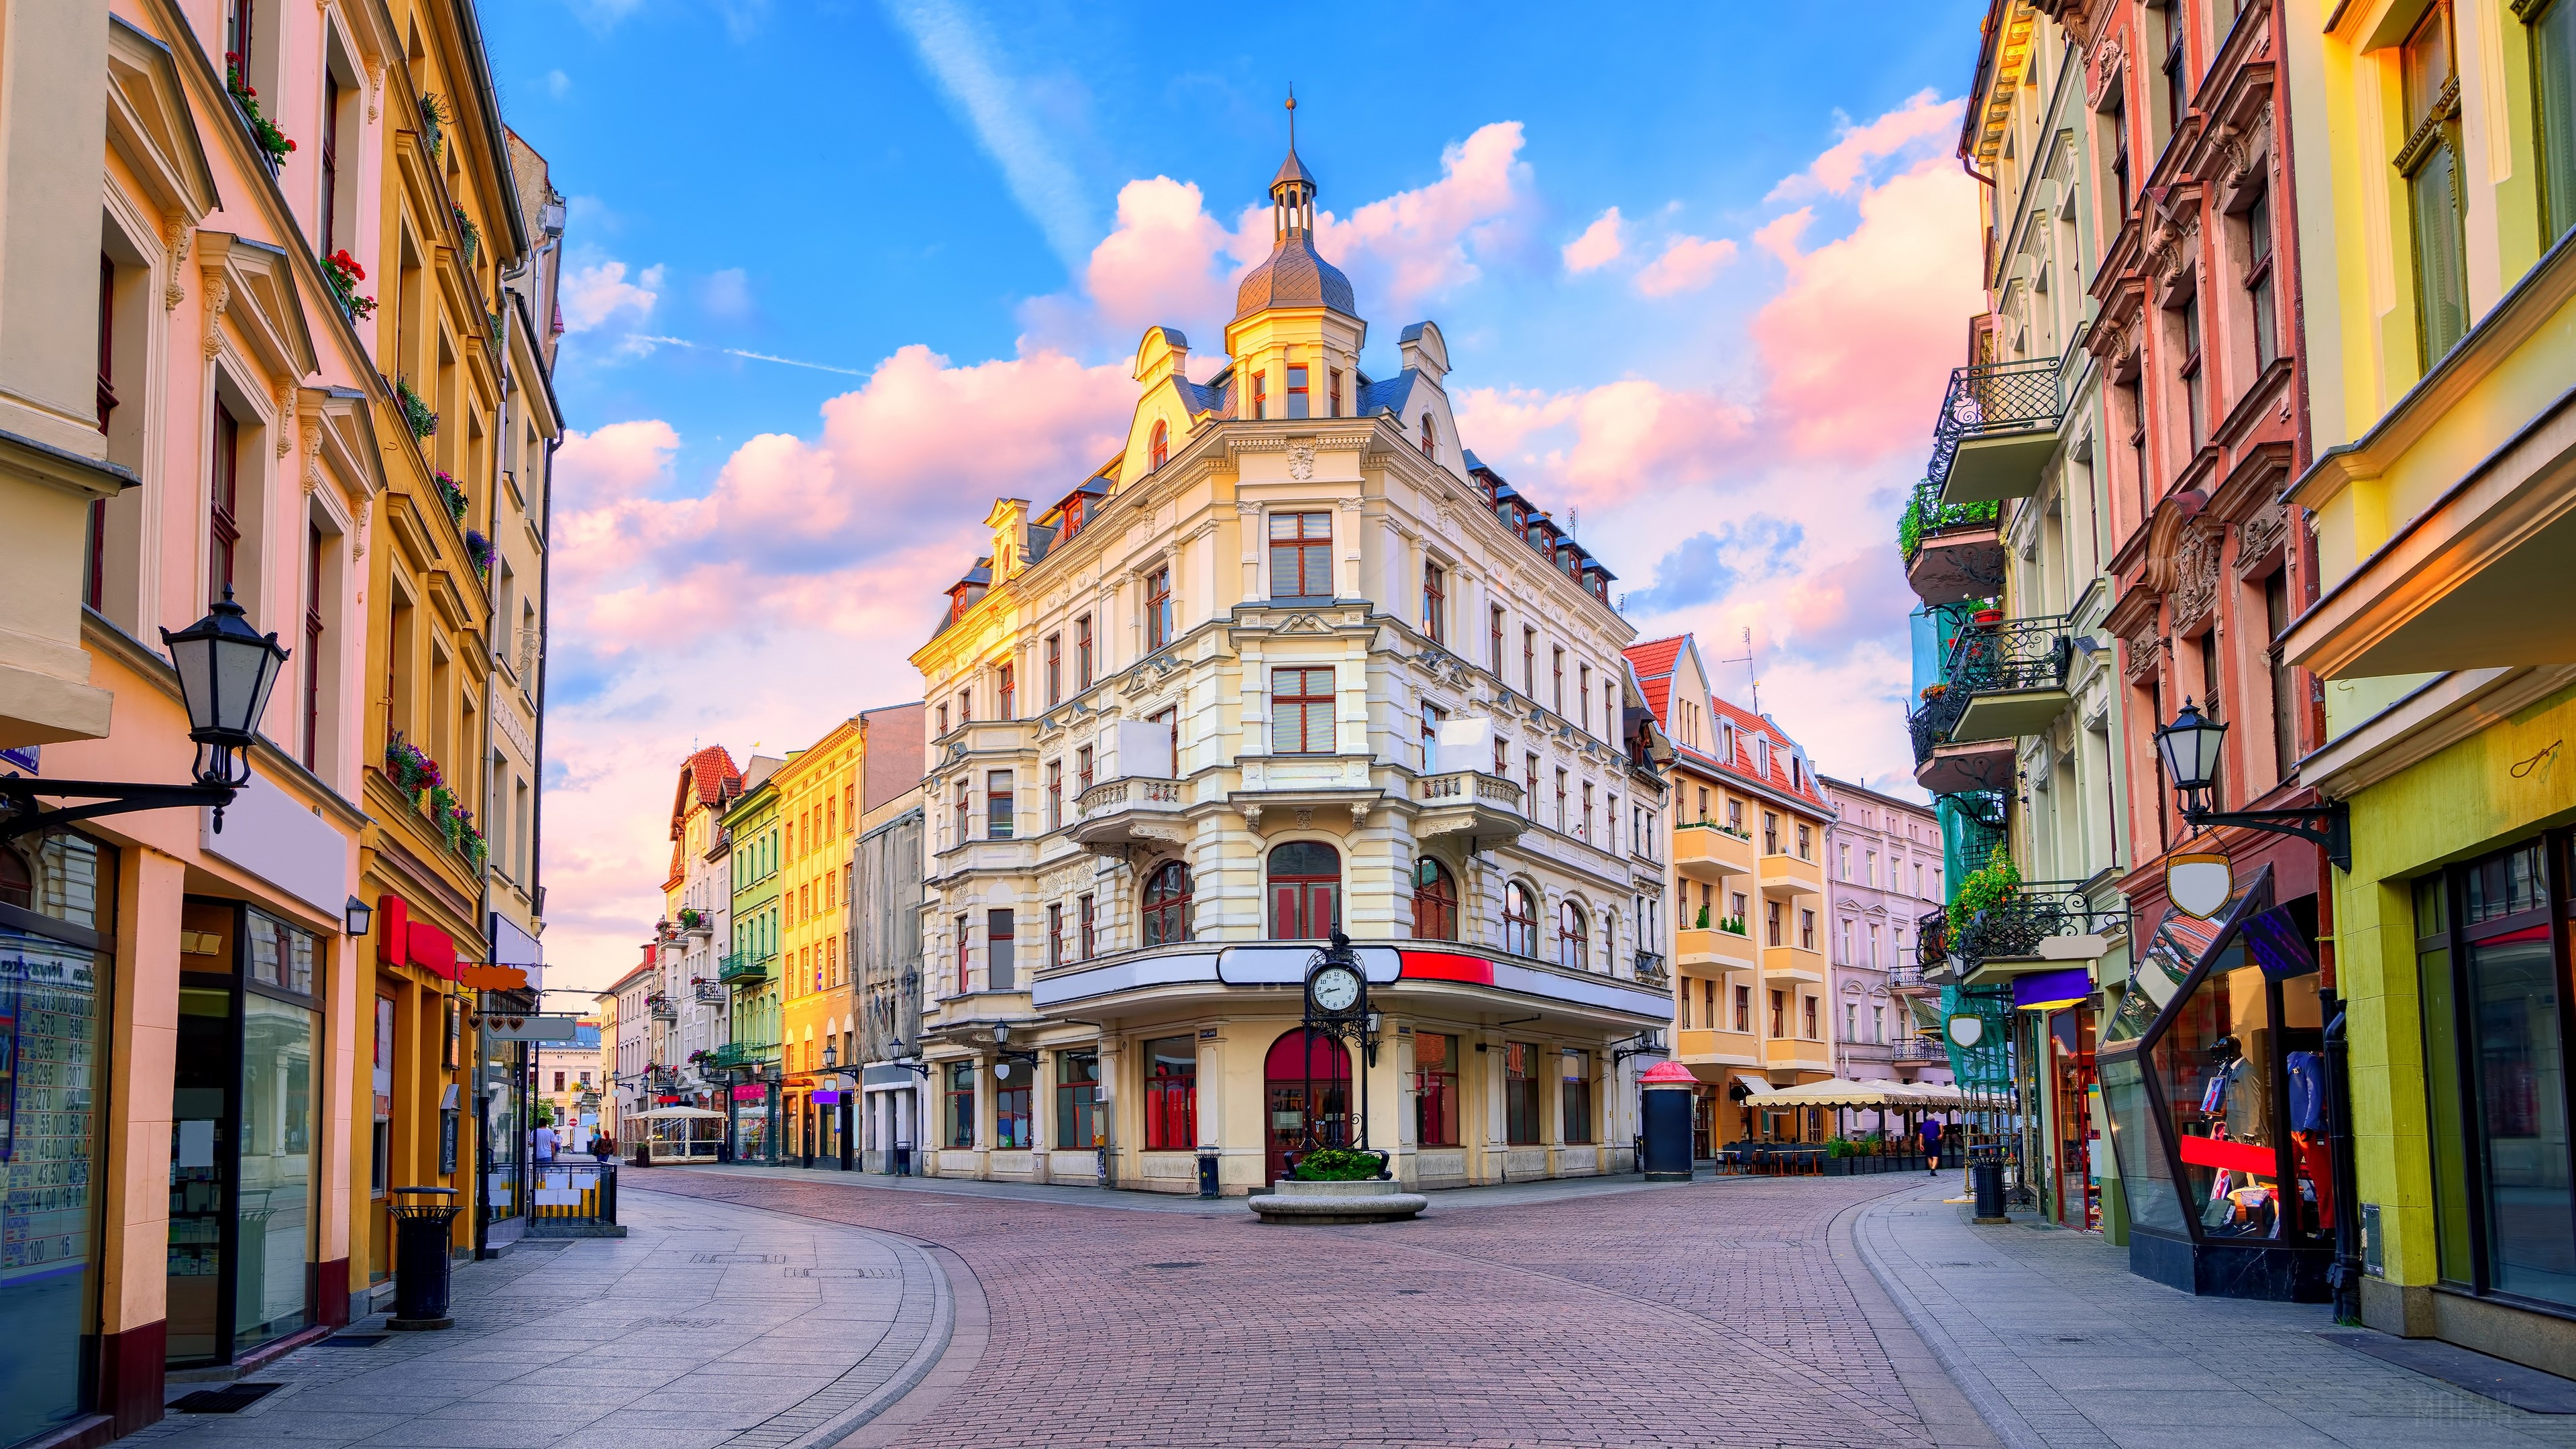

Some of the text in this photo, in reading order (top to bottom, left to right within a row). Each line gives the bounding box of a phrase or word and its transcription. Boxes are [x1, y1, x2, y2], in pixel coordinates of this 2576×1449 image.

[41, 988, 56, 1011] 373
[70, 994, 84, 1016] 388
[41, 1013, 55, 1035] 578
[70, 1018, 83, 1040] 598
[39, 1038, 54, 1060] 395
[68, 1042, 83, 1063] 415
[38, 1064, 53, 1085] 295
[68, 1066, 81, 1087] 307
[36, 1088, 52, 1110] 278
[66, 1089, 80, 1111] 290
[41, 1114, 50, 1135] 55
[54, 1114, 63, 1136] 00
[70, 1113, 79, 1135] 58
[40, 1138, 50, 1159] 46
[53, 1139, 62, 1160] 00
[70, 1138, 79, 1159] 49
[38, 1163, 48, 1185] 43
[51, 1163, 60, 1184] 50
[32, 1189, 41, 1212] 14
[46, 1188, 56, 1212] 00
[62, 1187, 71, 1208] 16
[7, 1216, 29, 1229] KORONA
[6, 1236, 70, 1263] FORINT 100 16
